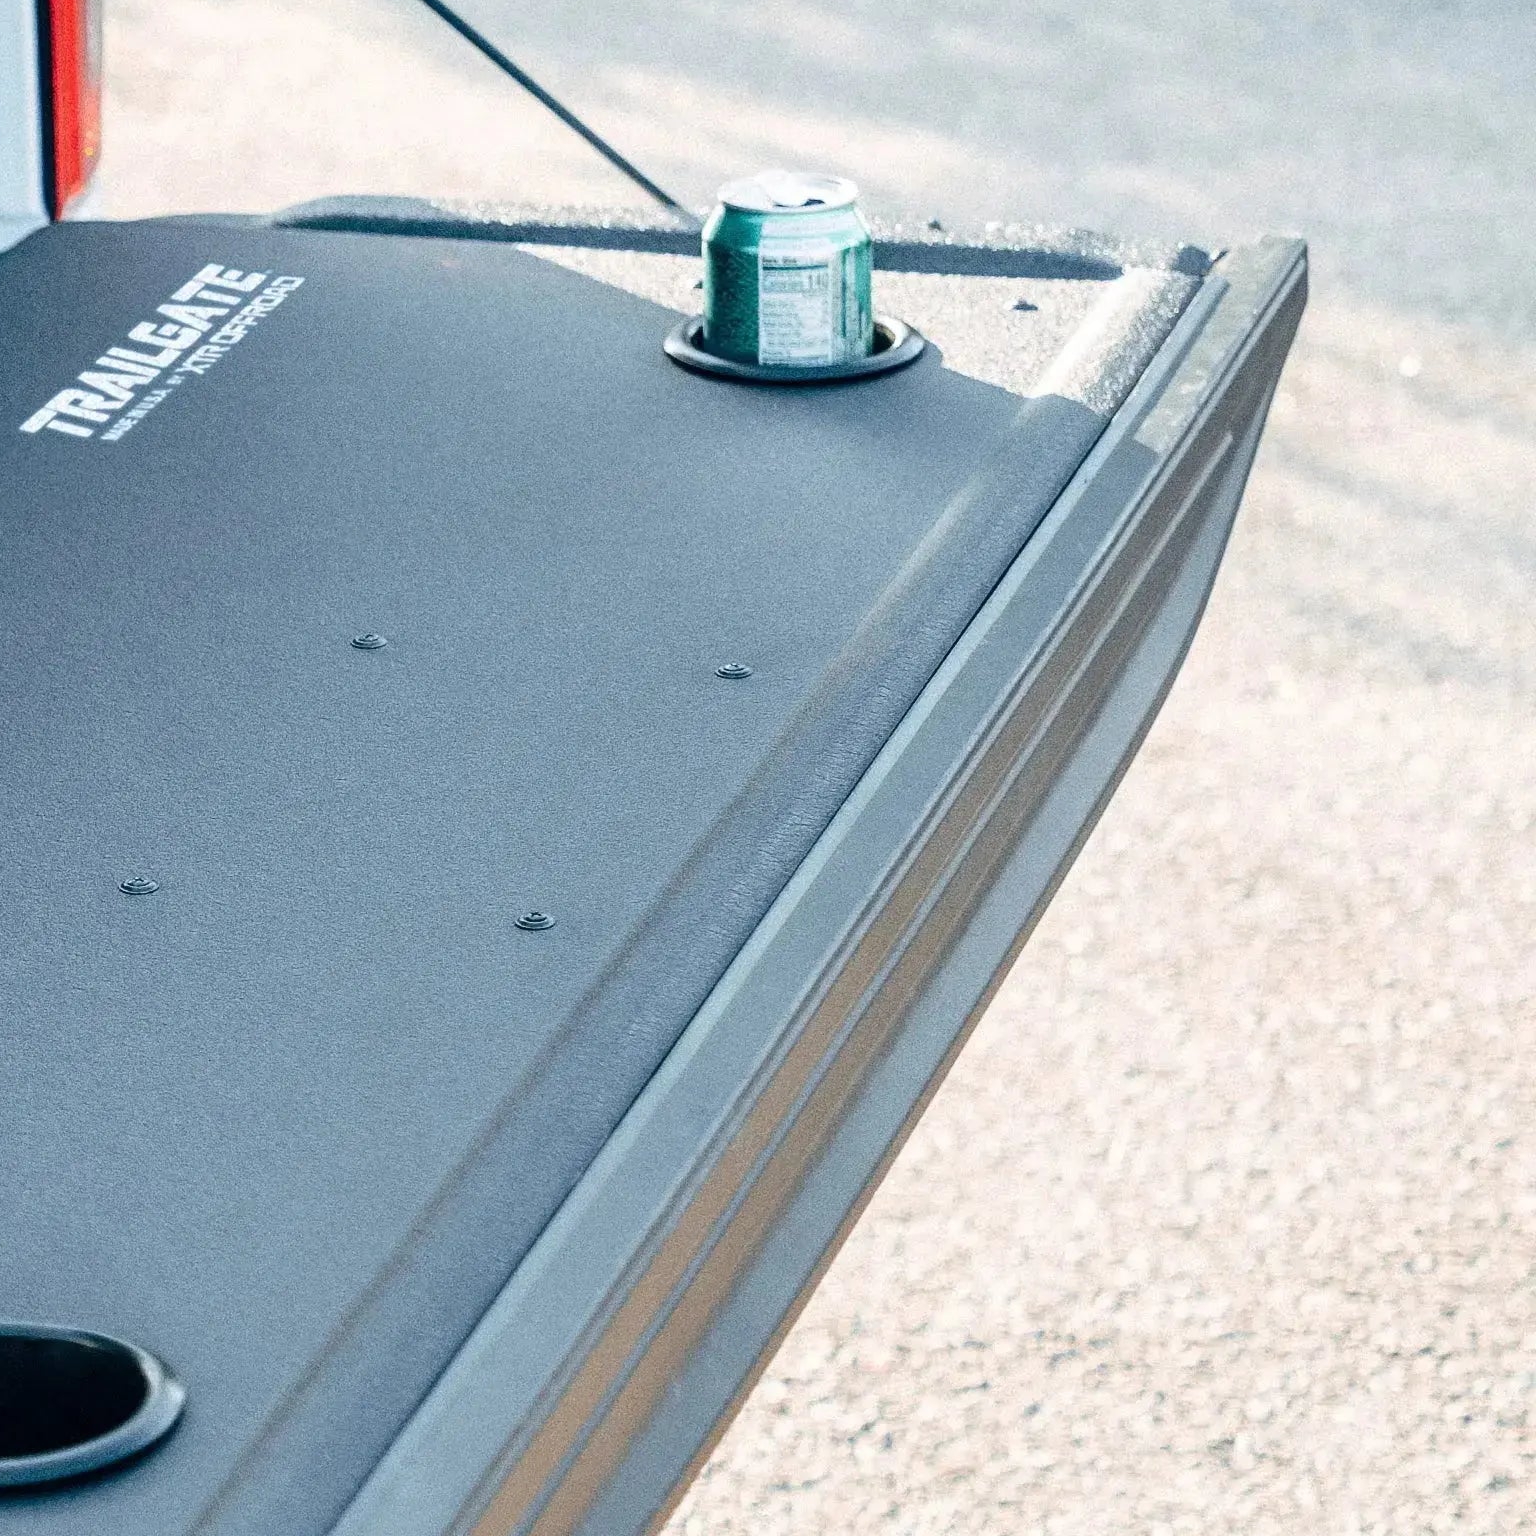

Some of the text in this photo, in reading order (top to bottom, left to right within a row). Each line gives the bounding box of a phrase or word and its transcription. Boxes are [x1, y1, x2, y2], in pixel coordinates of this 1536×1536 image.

[19, 264, 267, 437] TRAILGATE
[100, 417, 139, 441] MADE
[125, 408, 149, 419] IN
[175, 345, 231, 375] XTR
[208, 275, 306, 345] OFFROAD
